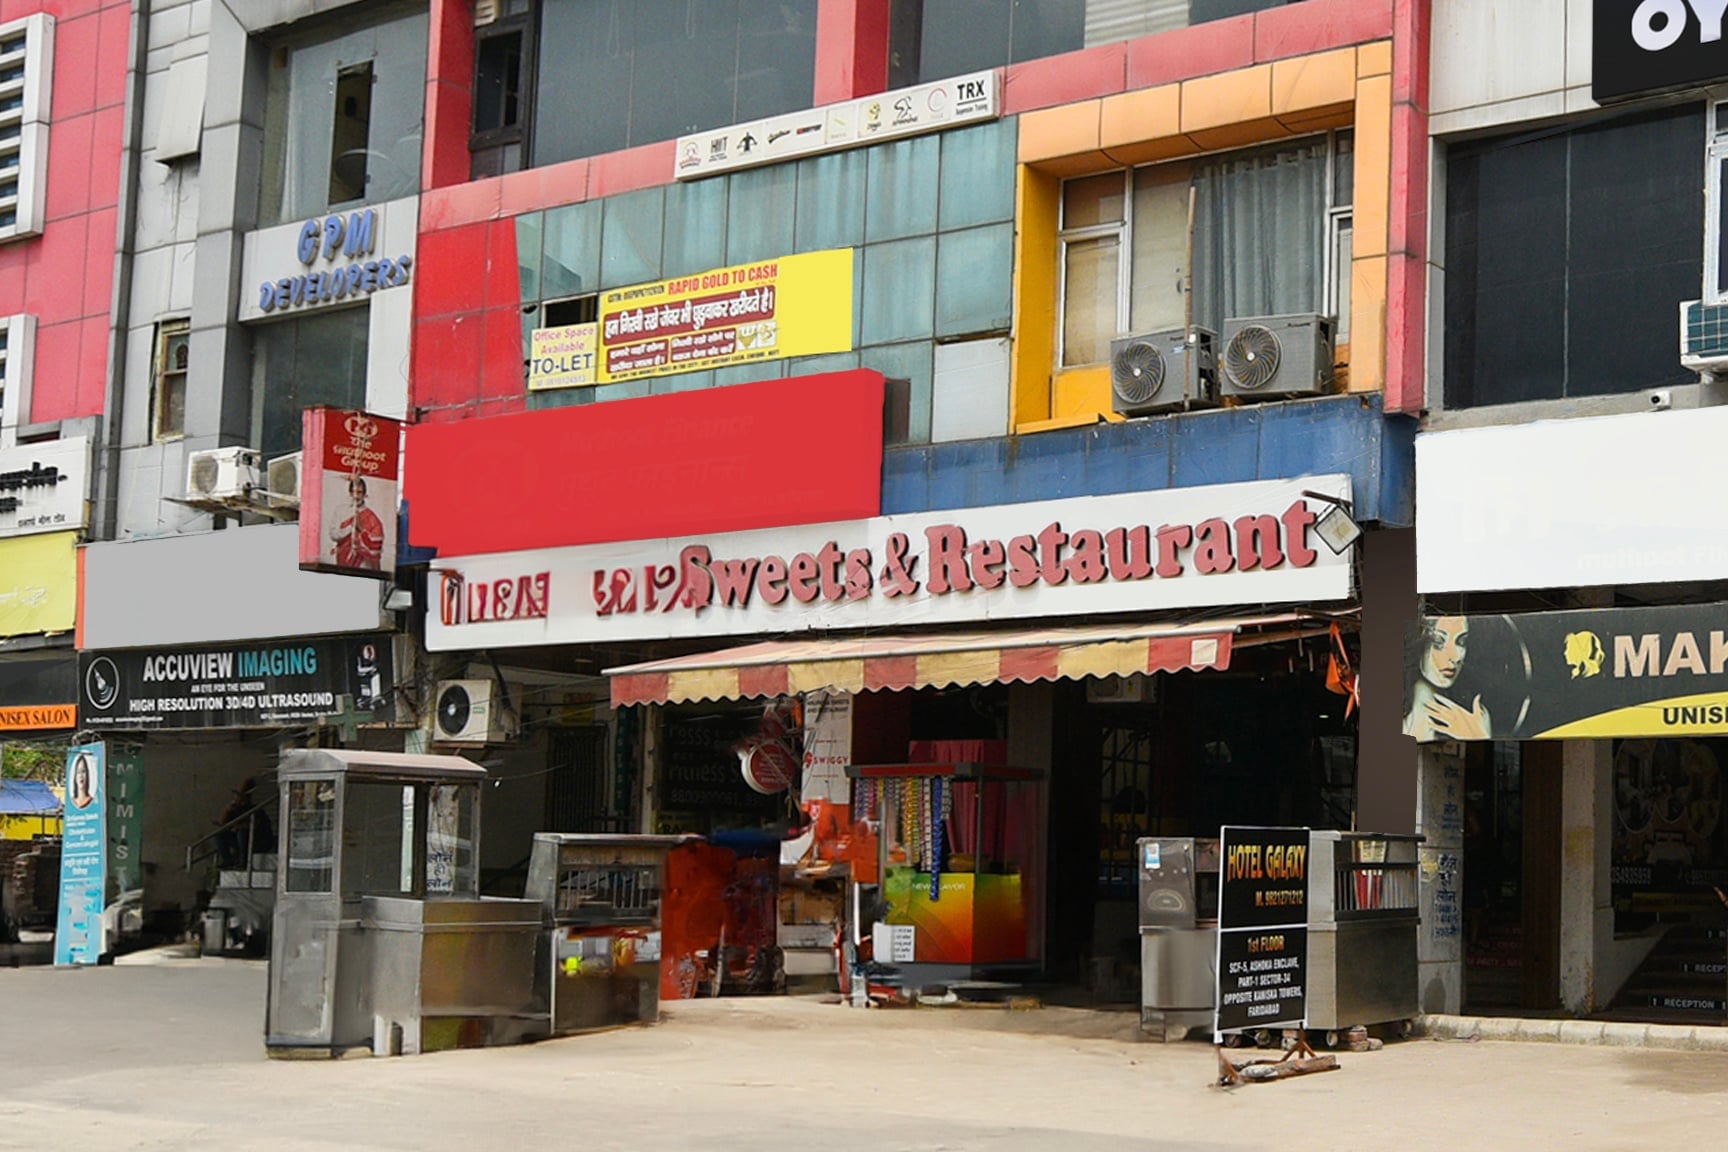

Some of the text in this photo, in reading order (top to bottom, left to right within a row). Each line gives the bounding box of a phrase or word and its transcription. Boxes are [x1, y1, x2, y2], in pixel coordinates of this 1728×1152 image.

[956, 80, 985, 100] TRX
[296, 207, 379, 266] GPM
[258, 254, 413, 313] DEVELOPERS
[668, 277, 699, 295] RAPID
[702, 272, 729, 290] GOLD
[733, 269, 745, 284] TO
[748, 264, 778, 281] CASH
[680, 539, 874, 615] Sweets
[878, 531, 919, 599] &
[924, 499, 1318, 596] Restaurant
[143, 647, 318, 682] ACCUVIEW IMAGING
[227, 683, 239, 692] THE
[129, 692, 333, 712] HIGH RESOLUTION 3D/4D ULTRASOUND
[33, 706, 72, 728] SALON
[813, 755, 849, 766] SWIGGY
[1227, 843, 1307, 883] HOTEL GALAXY
[1260, 935, 1285, 952] FLOOR
[1224, 990, 1253, 1005] OPPOSITE
[1664, 997, 1715, 1009] RECEPTION
[1247, 1003, 1281, 1018] FARIDABAD
